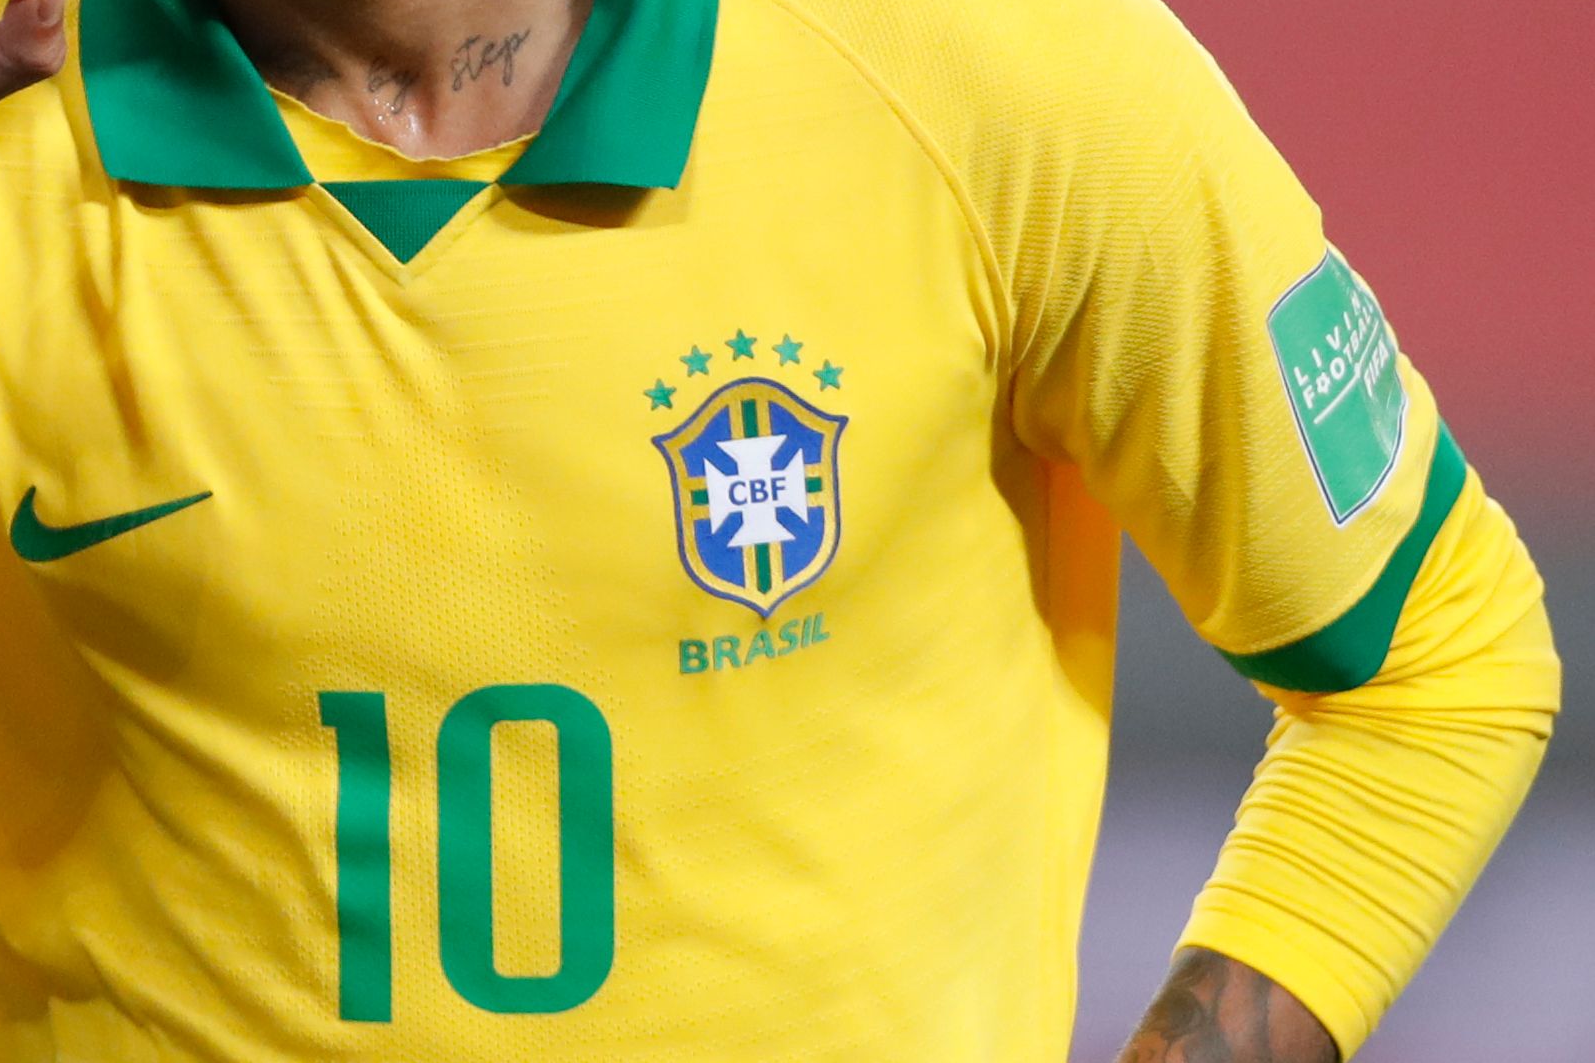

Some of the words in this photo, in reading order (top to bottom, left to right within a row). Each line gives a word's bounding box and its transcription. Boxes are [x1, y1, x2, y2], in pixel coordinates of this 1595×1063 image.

[1363, 338, 1391, 398] FIFA
[727, 476, 788, 506] CBF
[678, 611, 831, 675] BRASIL
[317, 682, 616, 1024] 10
